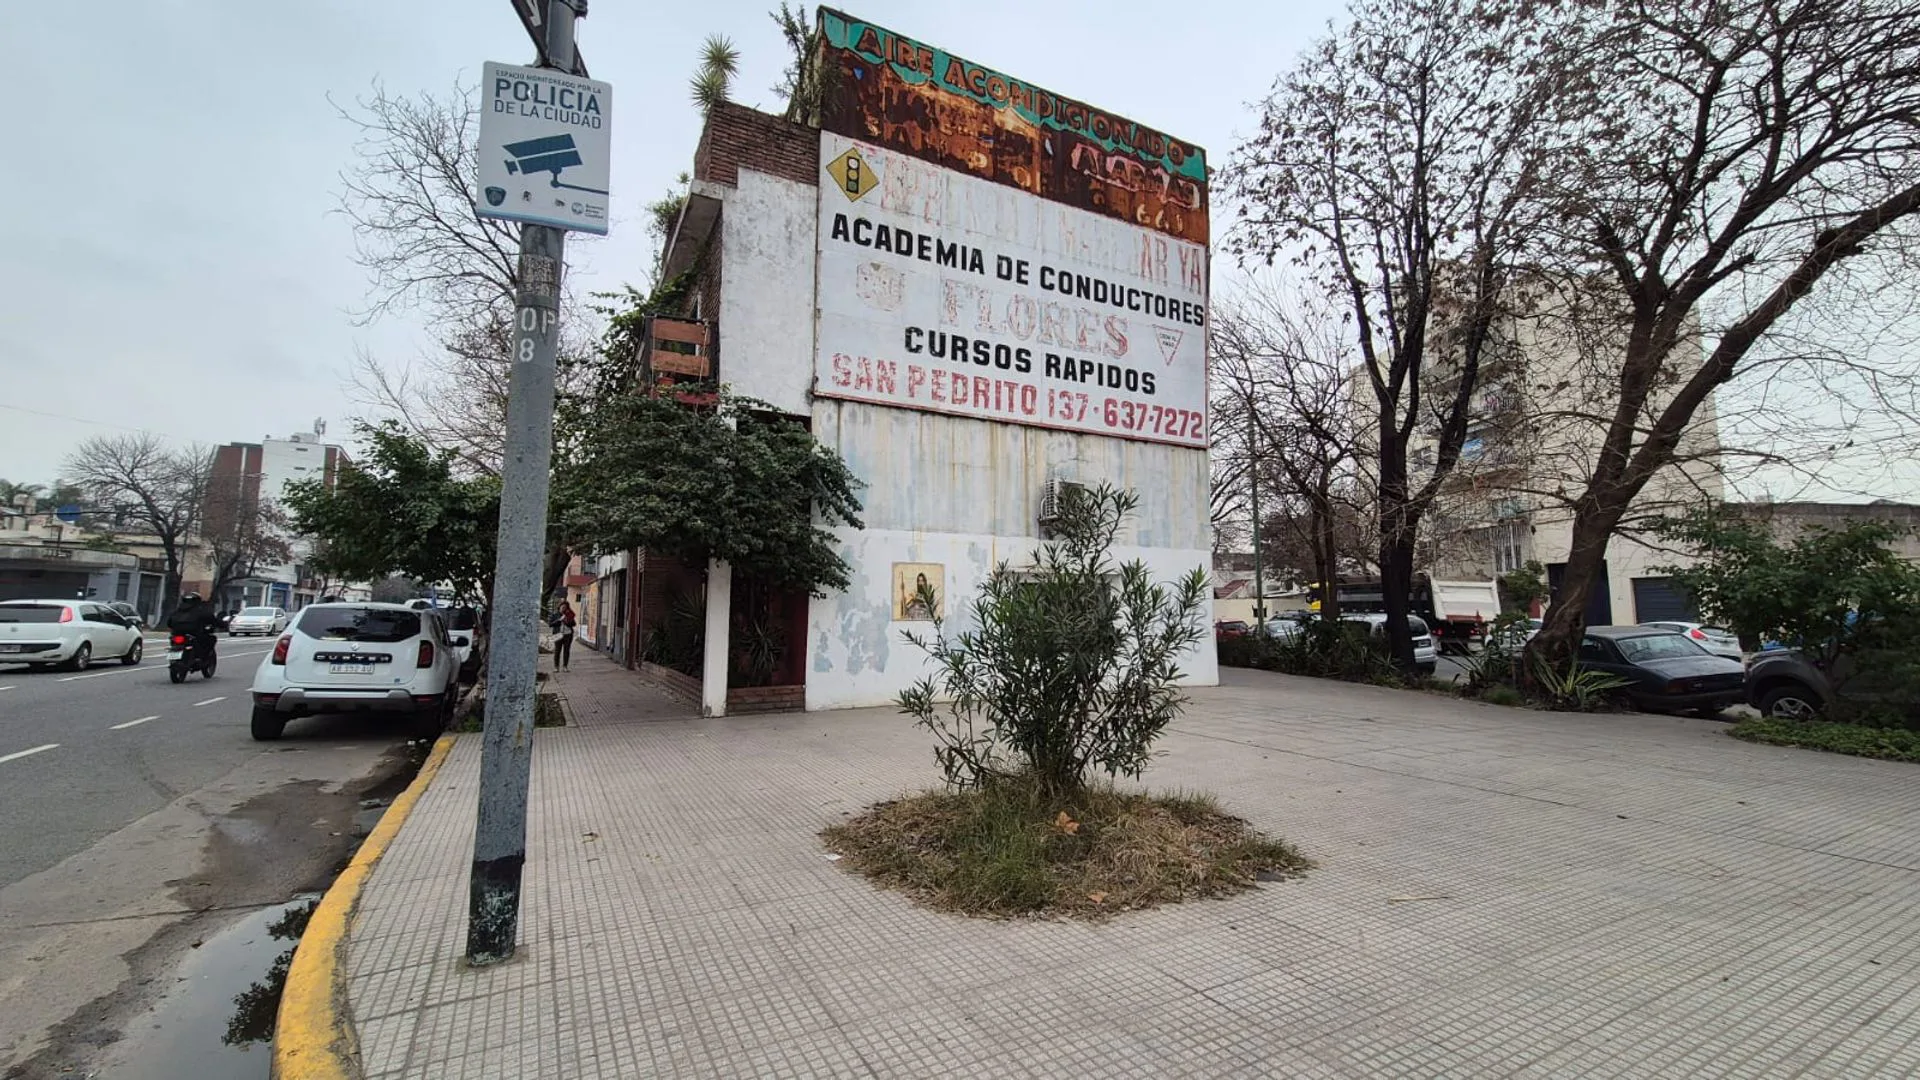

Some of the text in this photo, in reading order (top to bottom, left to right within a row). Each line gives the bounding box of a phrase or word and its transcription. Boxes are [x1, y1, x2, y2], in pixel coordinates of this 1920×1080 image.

[495, 78, 601, 116] POLICIA
[496, 69, 525, 80] ESPACIO
[855, 27, 933, 78] AIRE
[944, 60, 1186, 166] ACONDICIONADO
[494, 99, 602, 130] DE LA CIUDAD
[831, 212, 985, 275] ACADEMIA
[996, 253, 1030, 285] DE
[1039, 265, 1205, 327] CONDUCTORES
[940, 278, 1129, 360] FLORES
[831, 352, 897, 395] SAN
[907, 364, 1038, 416] PEDRITO
[1048, 388, 1089, 422] 137
[904, 326, 1156, 395] CURSOS RAPIDOS
